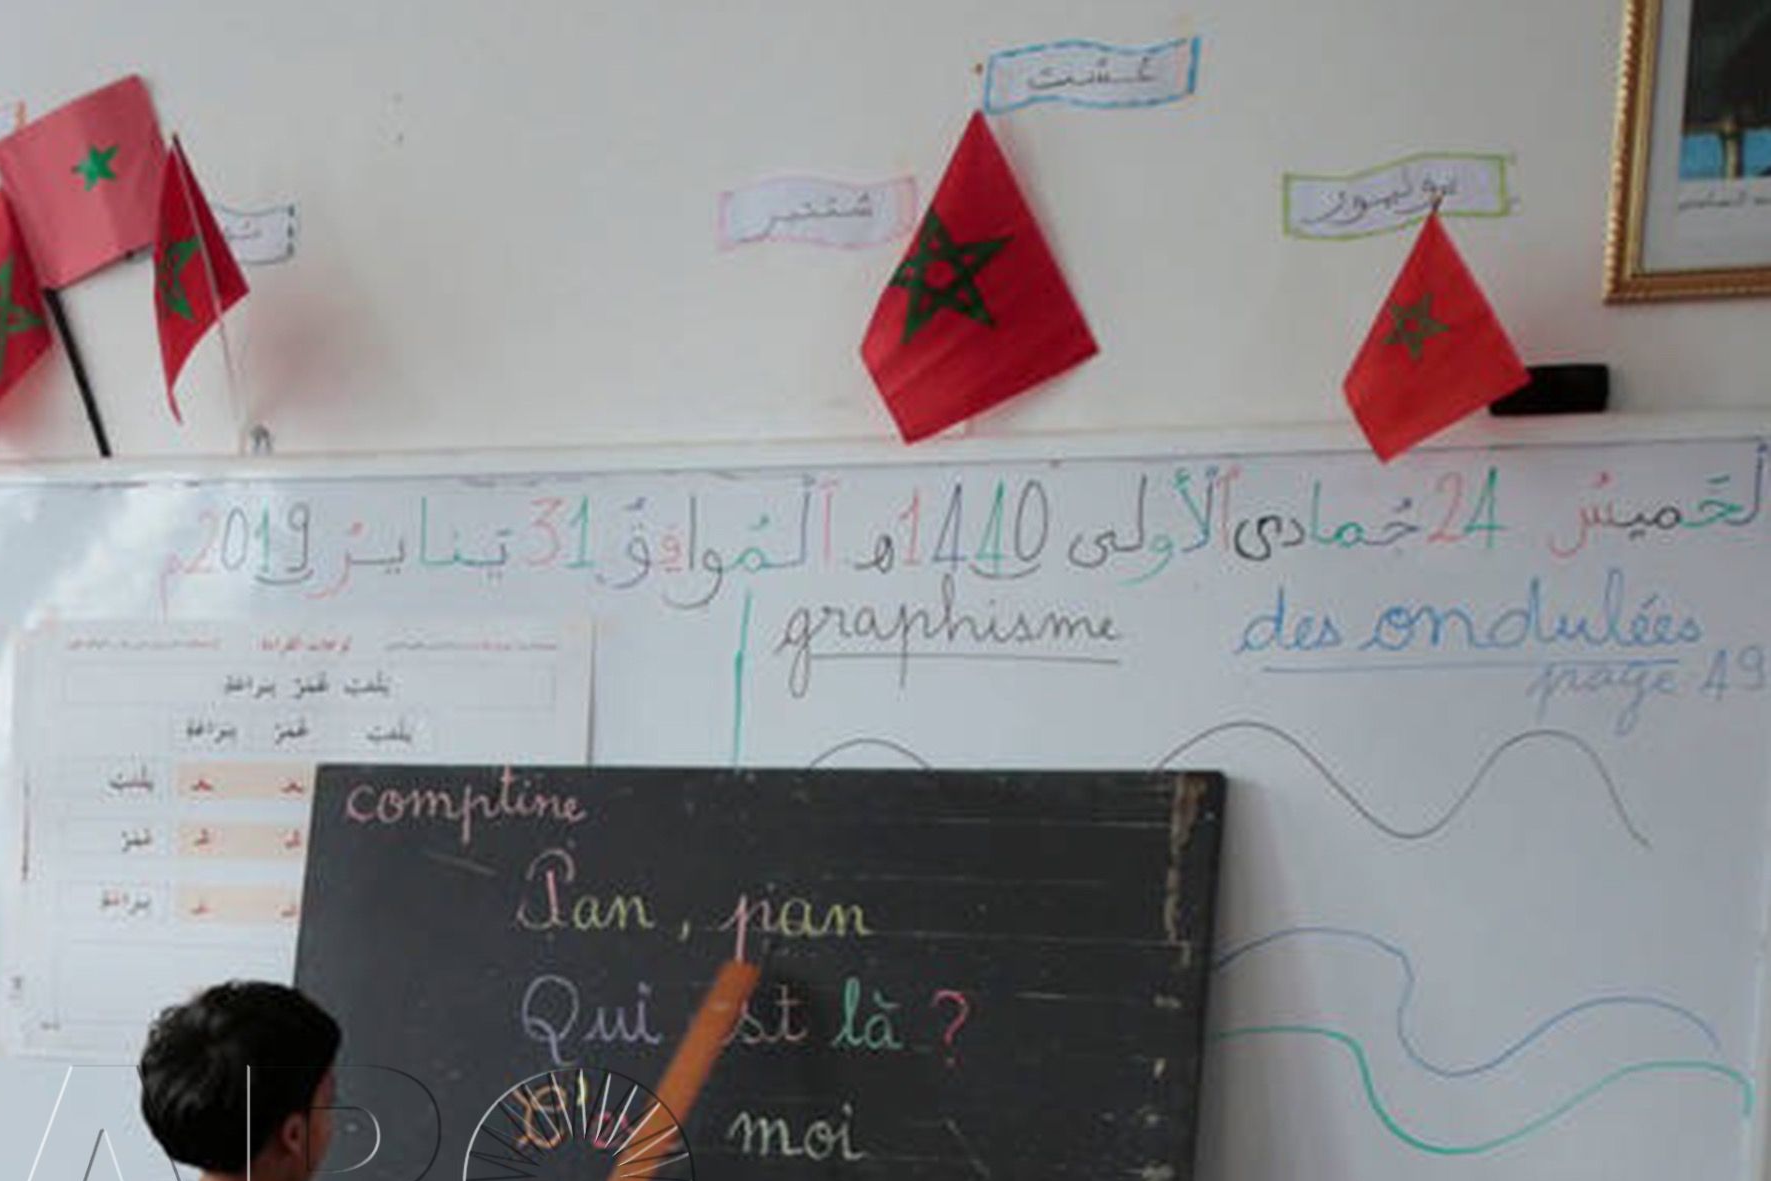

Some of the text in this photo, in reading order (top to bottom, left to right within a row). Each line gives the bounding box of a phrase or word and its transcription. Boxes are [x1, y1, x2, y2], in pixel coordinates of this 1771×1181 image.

[528, 497, 598, 570] 31
[898, 478, 1050, 580] 1440
[1428, 466, 1506, 549] 24
[776, 576, 1122, 698] graphisme
[1233, 567, 1704, 653] des ondulées
[1528, 658, 1679, 738] page
[345, 765, 589, 846] comptine
[717, 893, 878, 963] pan
[522, 975, 665, 1067] Qui
[722, 984, 810, 1046] st
[832, 976, 904, 1050] là
[727, 1102, 869, 1164] moi
